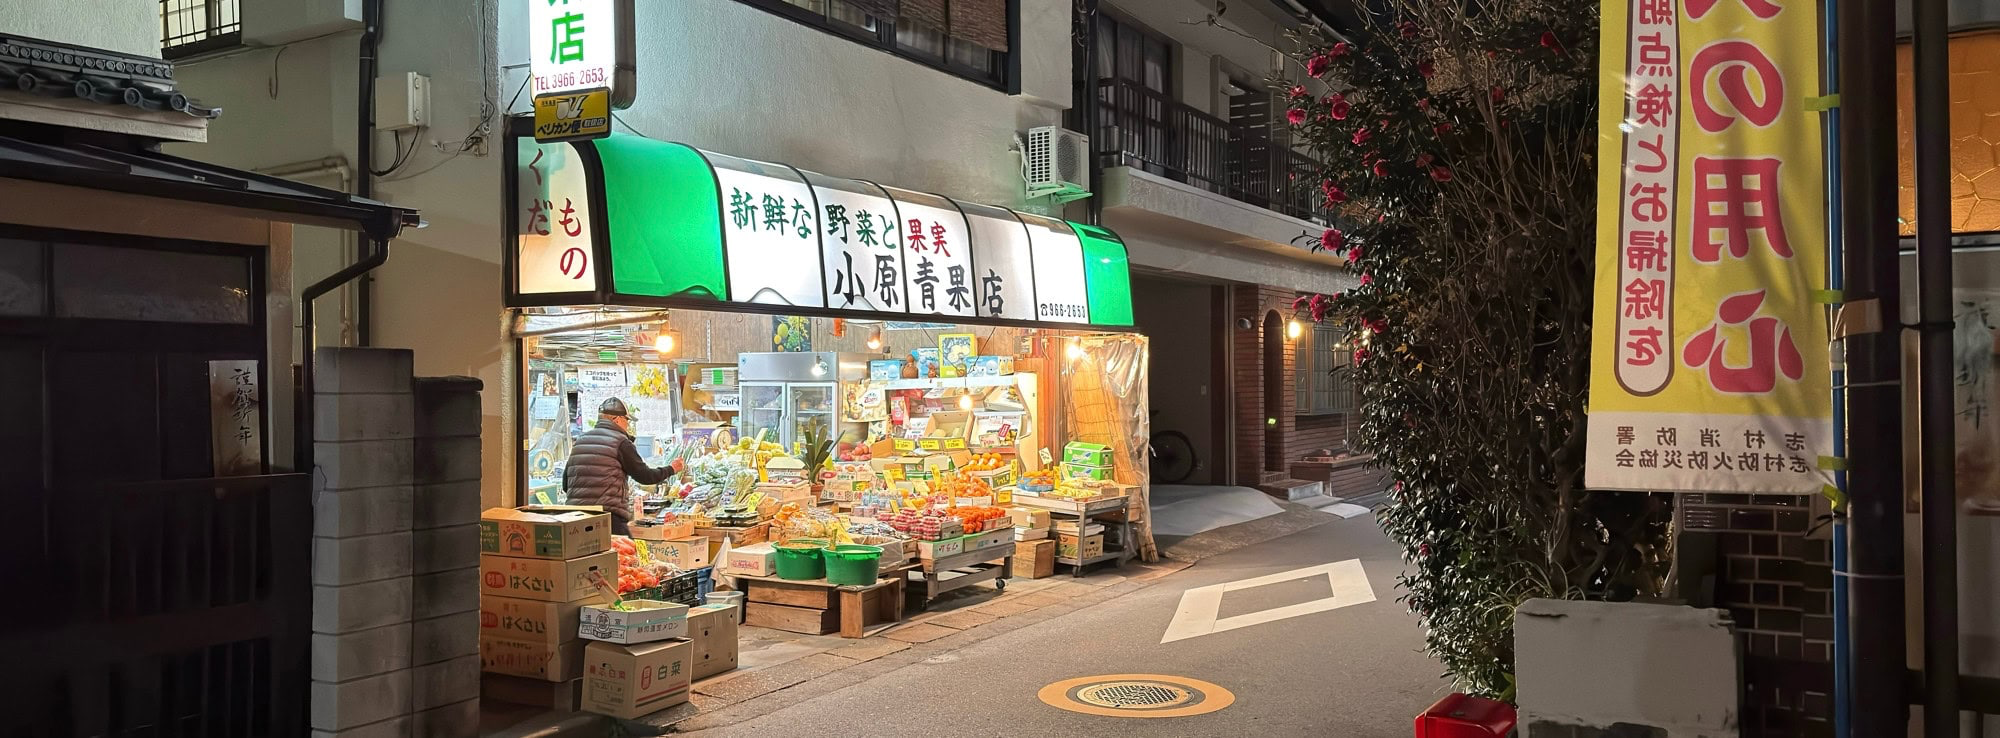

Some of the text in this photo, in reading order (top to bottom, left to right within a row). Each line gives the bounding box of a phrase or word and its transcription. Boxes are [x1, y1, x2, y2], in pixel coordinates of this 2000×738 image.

[548, 0, 584, 64] 店
[535, 67, 604, 91] TEL 3966 2653
[537, 120, 581, 135] ペリカン便
[833, 251, 1004, 314] 小原青果店
[510, 575, 554, 592] はくさい
[503, 616, 545, 633] はくさい
[658, 661, 682, 680] 白菜
